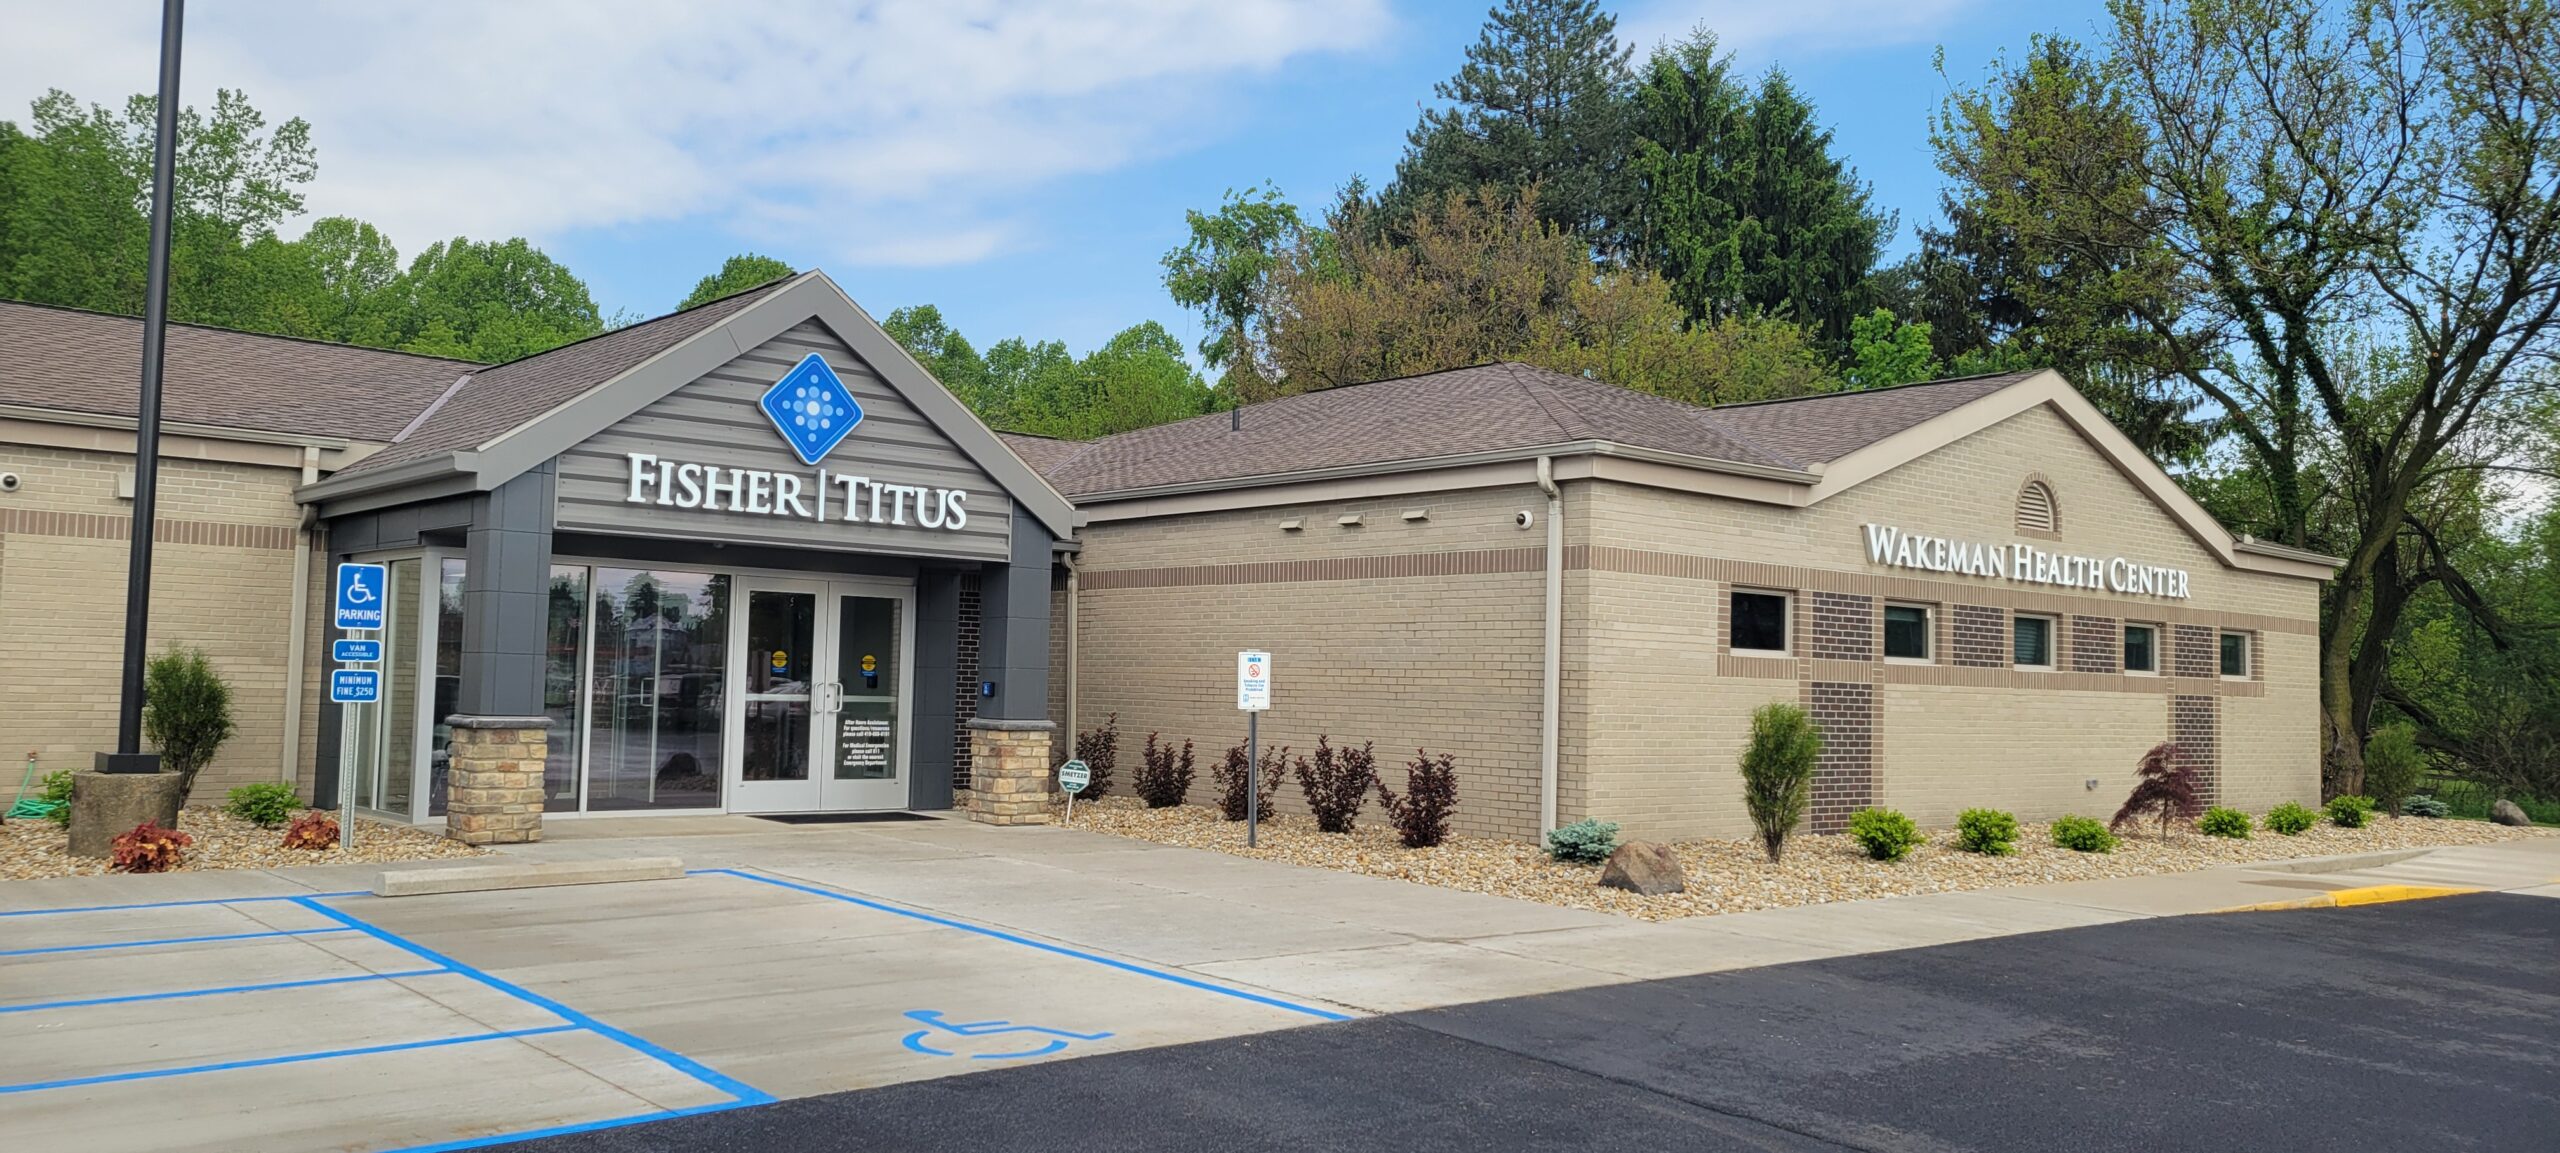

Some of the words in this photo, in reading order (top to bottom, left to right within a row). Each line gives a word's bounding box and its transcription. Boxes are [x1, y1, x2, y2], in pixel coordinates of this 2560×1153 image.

[626, 452, 811, 518] FISHER
[834, 473, 968, 531] TITUS
[1864, 523, 2006, 578] WAKEMAN
[2012, 543, 2104, 591] HEALTH
[2107, 556, 2191, 599] CENTER
[339, 608, 380, 621] PARKING
[349, 644, 366, 652] VAN
[339, 676, 372, 685] MINIMUM
[336, 686, 354, 696] FINE
[354, 686, 374, 697] $250
[1061, 770, 1088, 779] SMETZER
